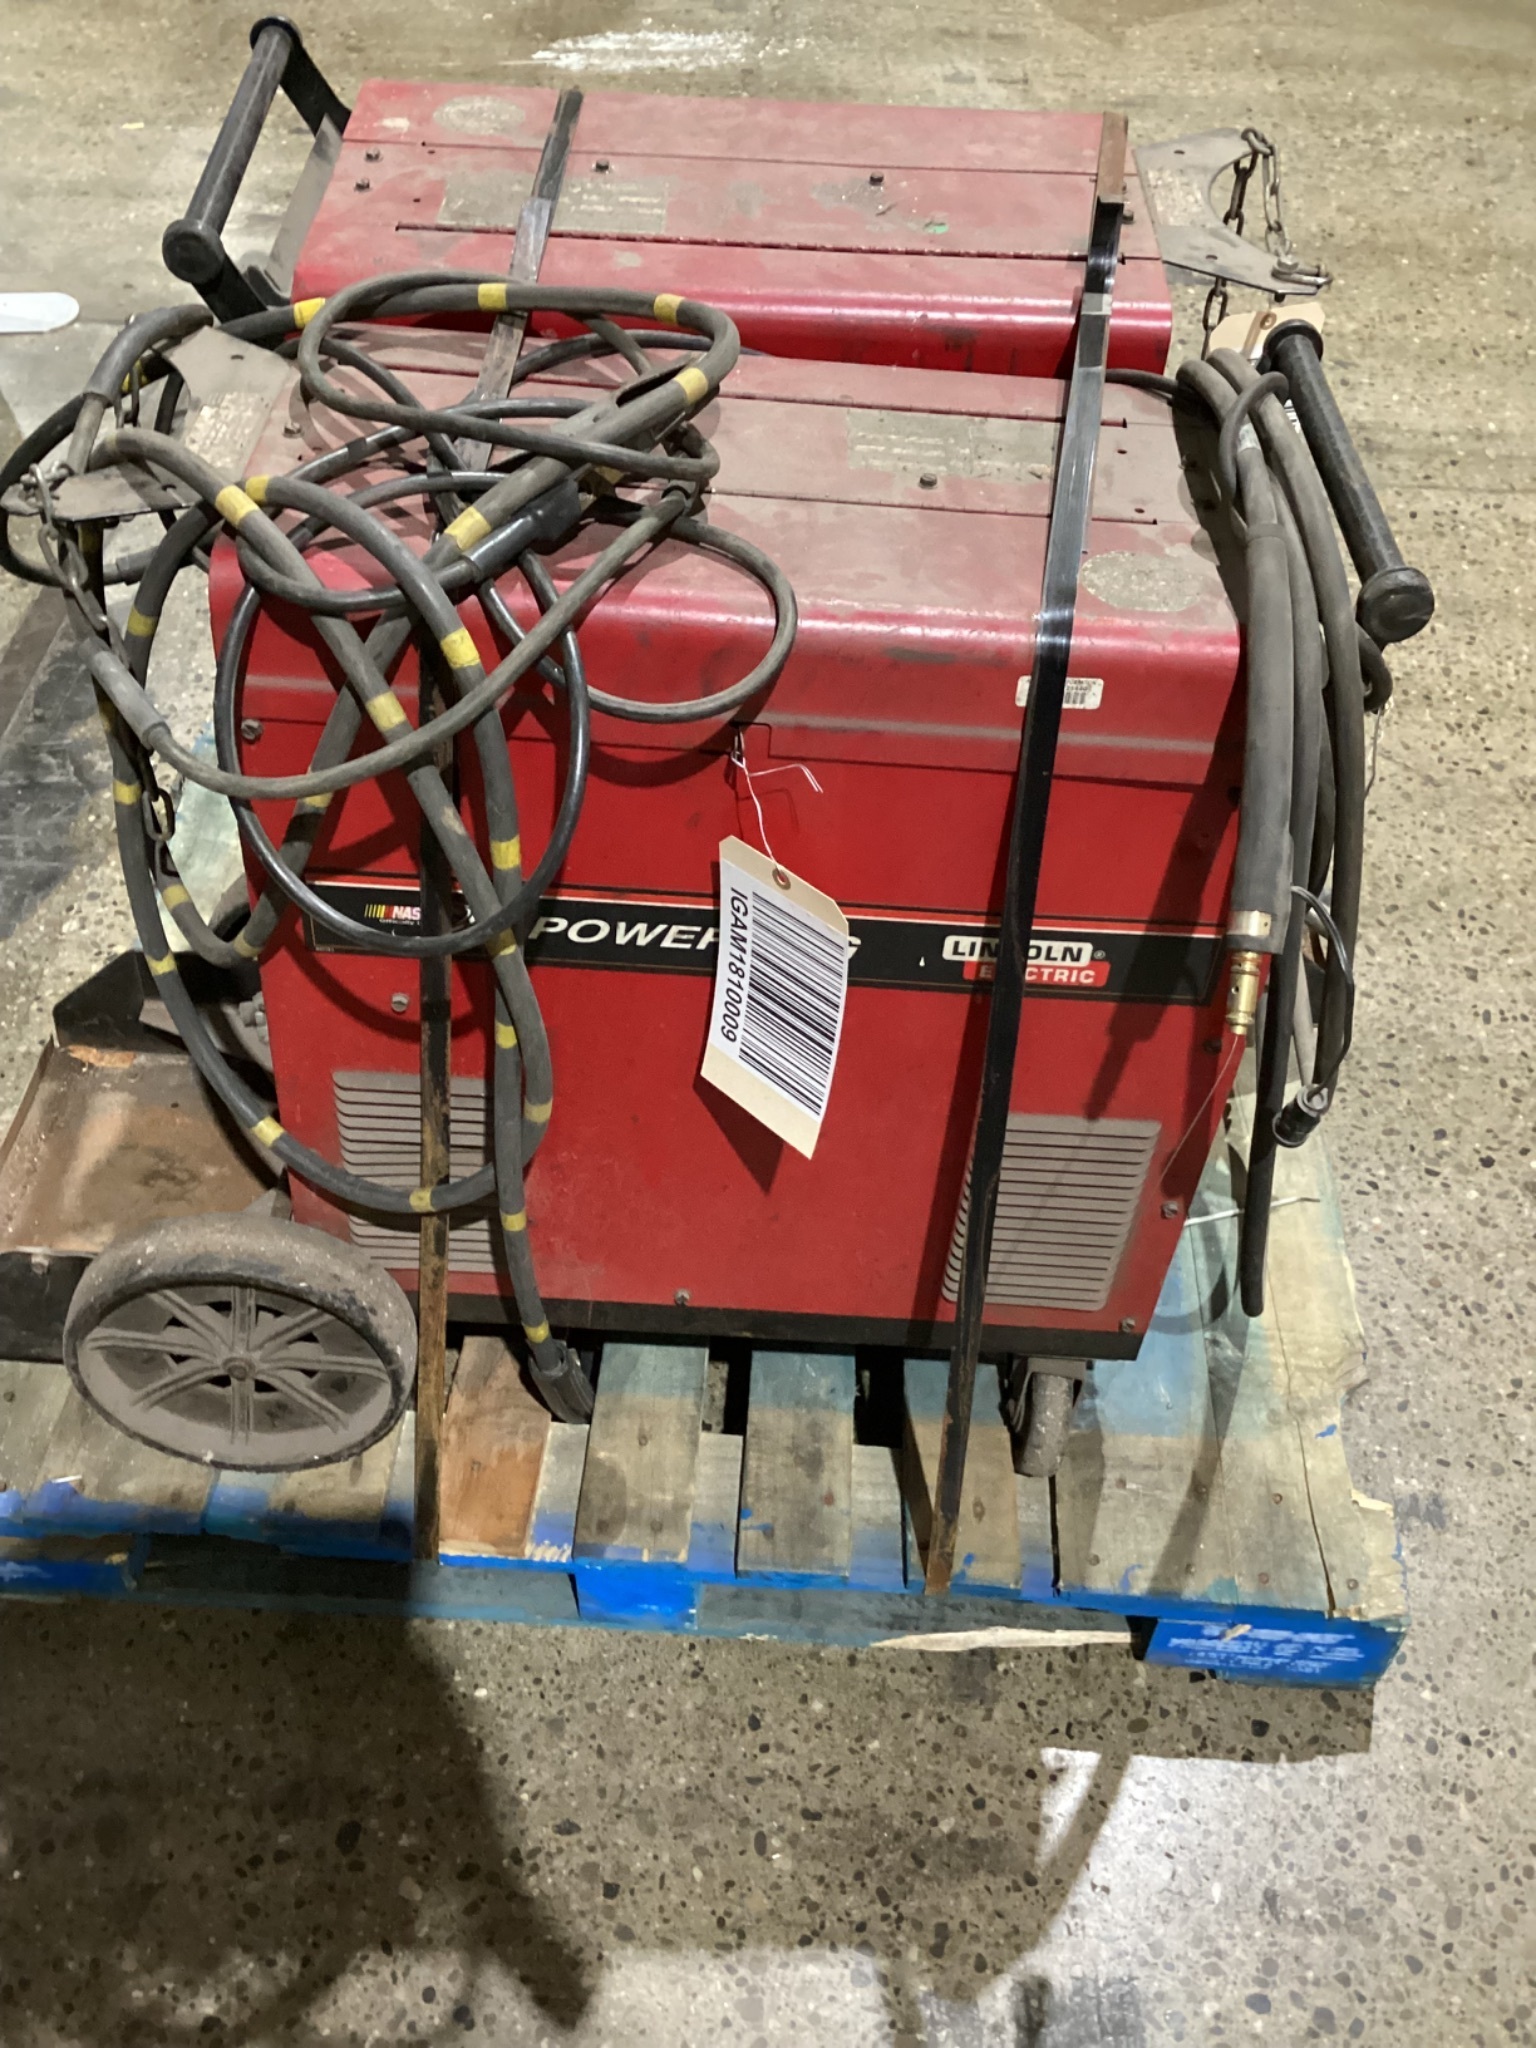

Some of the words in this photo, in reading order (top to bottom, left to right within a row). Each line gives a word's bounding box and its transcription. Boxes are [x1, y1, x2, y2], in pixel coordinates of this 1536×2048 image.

[392, 904, 421, 920] NAS
[951, 939, 1084, 963] LINOLN
[720, 886, 749, 1043] IGAM1810009
[979, 964, 1096, 984] ECTRIC
